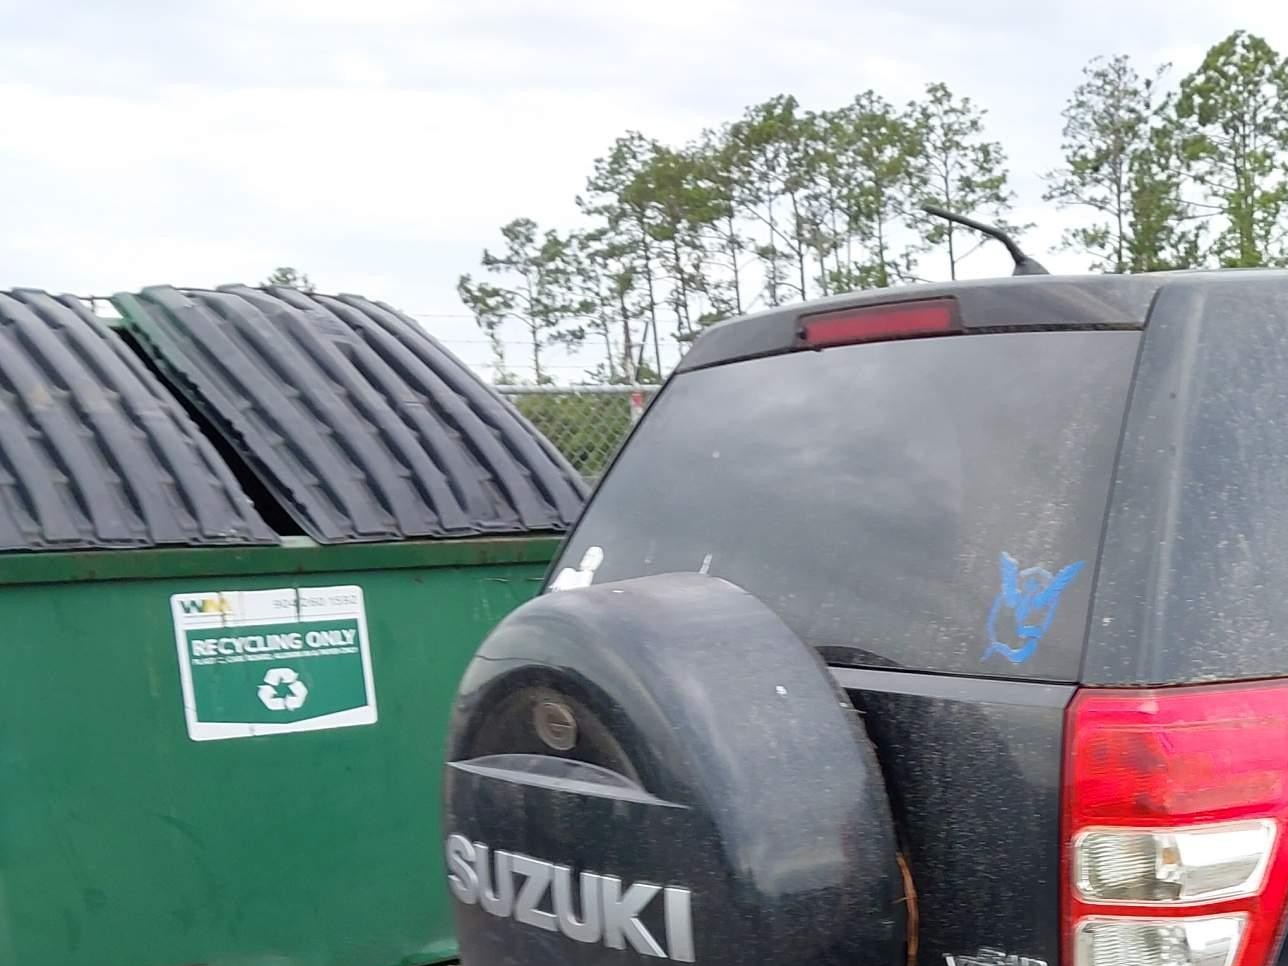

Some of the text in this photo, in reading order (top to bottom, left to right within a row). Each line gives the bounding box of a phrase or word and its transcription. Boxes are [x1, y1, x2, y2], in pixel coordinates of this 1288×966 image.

[191, 628, 357, 656] RECYCLING ONLY
[446, 834, 695, 962] SUZUKI
